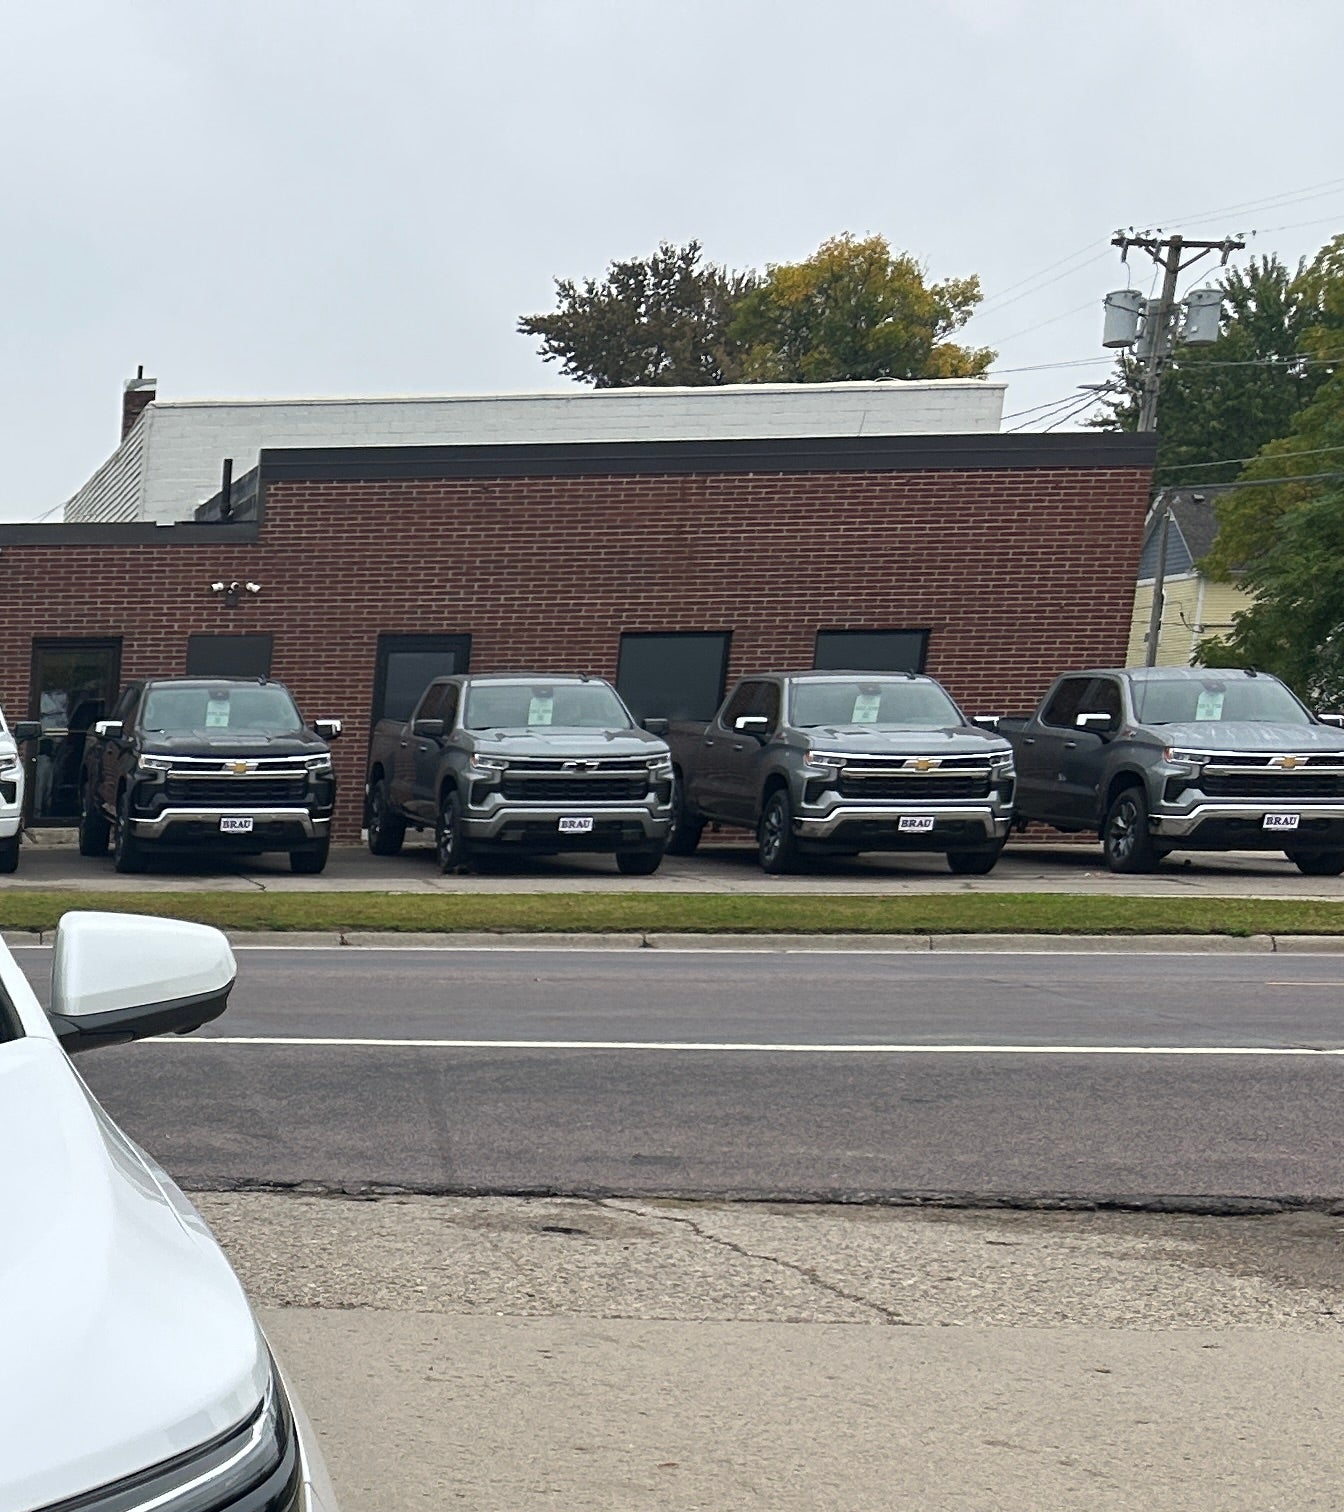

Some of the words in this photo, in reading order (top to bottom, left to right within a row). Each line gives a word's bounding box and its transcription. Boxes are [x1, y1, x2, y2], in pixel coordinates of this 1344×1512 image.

[222, 820, 251, 829] BRAU
[561, 820, 591, 829] BRAU
[900, 819, 931, 828] BRAU
[1265, 816, 1297, 826] BRAU
